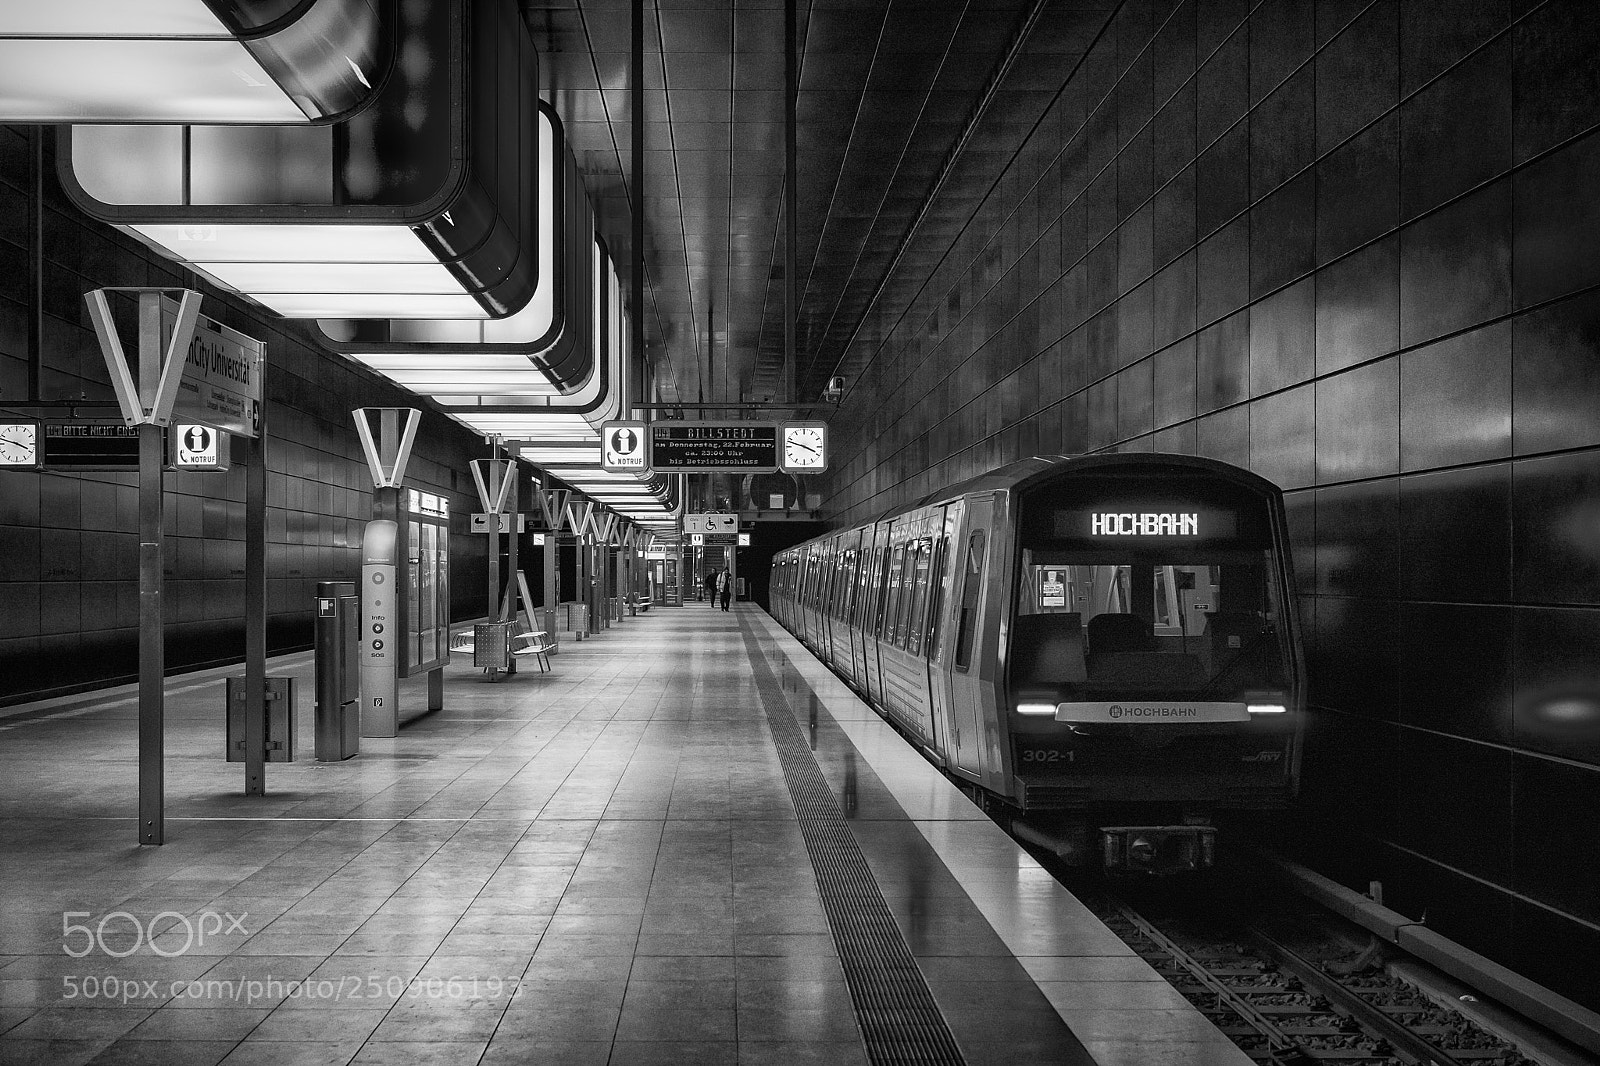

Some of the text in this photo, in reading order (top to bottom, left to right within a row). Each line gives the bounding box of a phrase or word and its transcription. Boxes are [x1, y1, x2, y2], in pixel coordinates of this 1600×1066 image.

[63, 425, 88, 437] BITTE
[91, 425, 115, 437] NICHT
[688, 428, 755, 439] BILLSTEDT
[669, 441, 721, 449] Donnerstag,
[190, 455, 216, 464] NOTRUF
[617, 457, 643, 465] NOTRUF
[1091, 513, 1198, 536] HOCHBAHN
[1124, 707, 1197, 717] HOCHBAHN
[1022, 750, 1075, 762] 302-1
